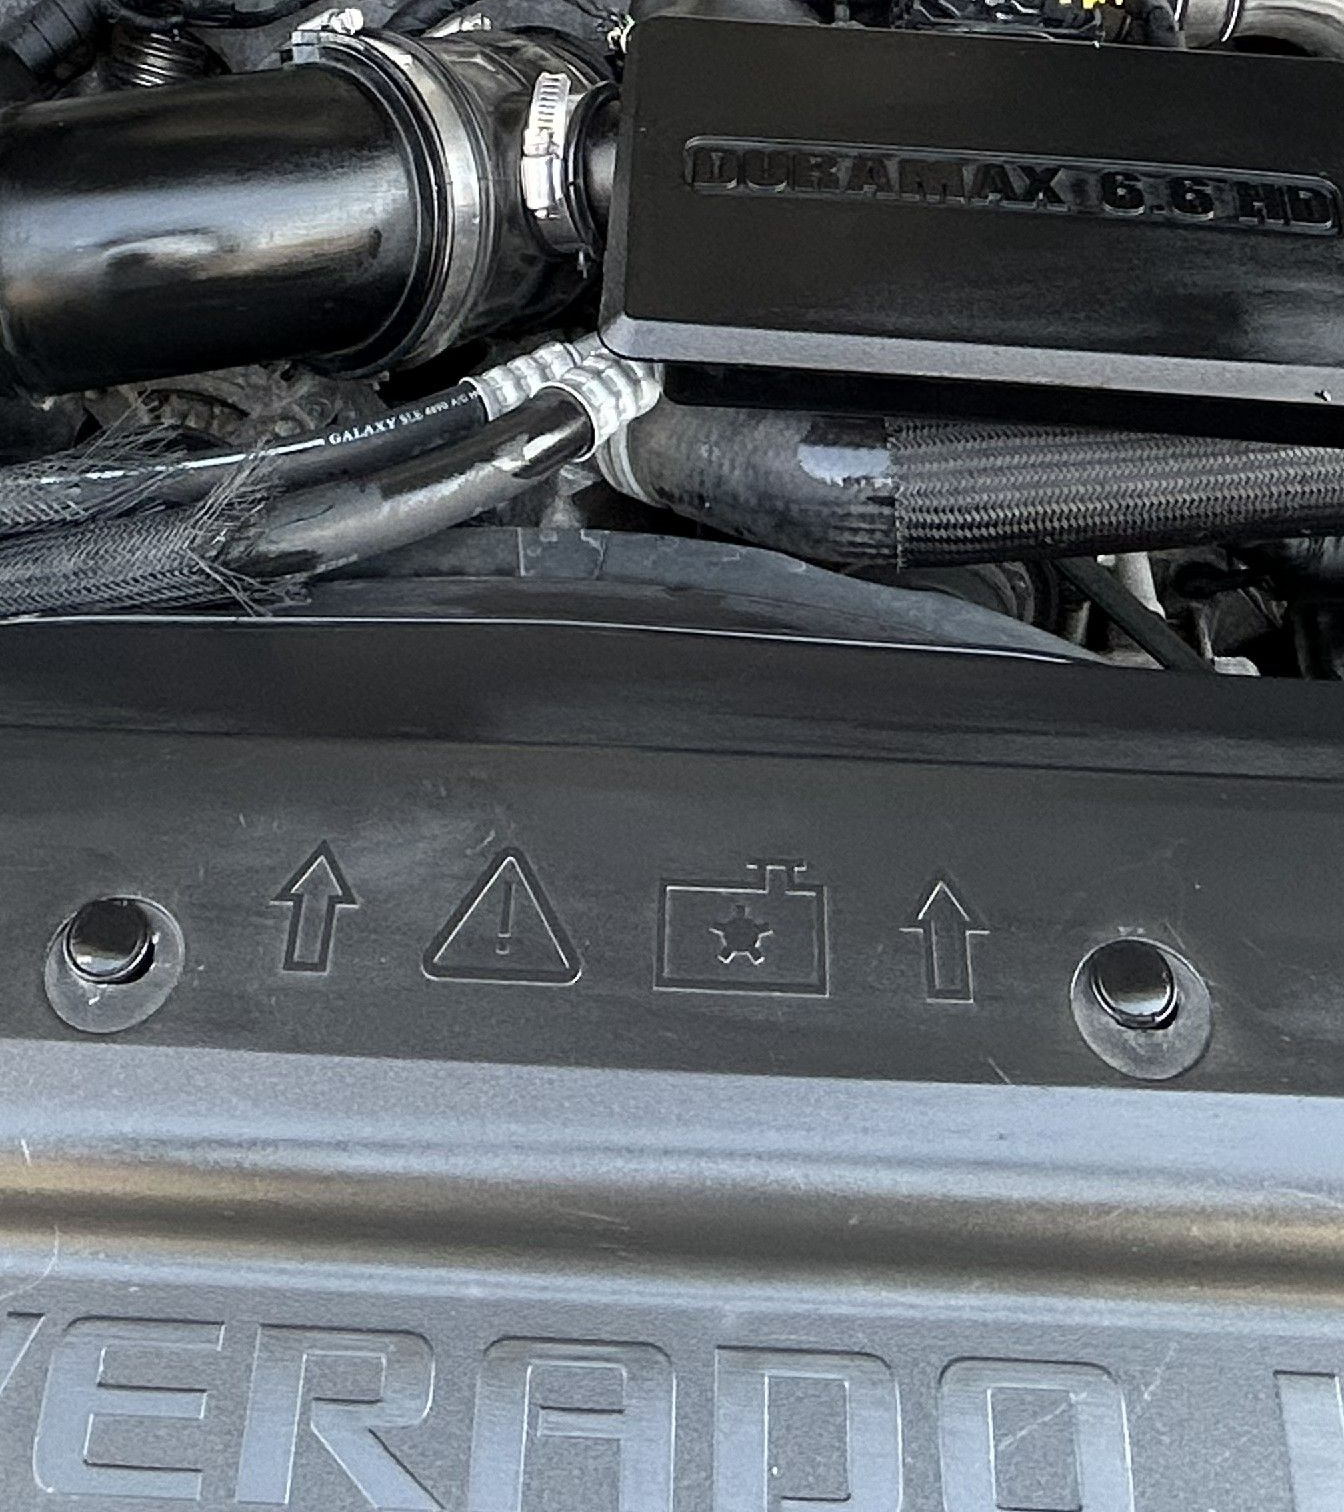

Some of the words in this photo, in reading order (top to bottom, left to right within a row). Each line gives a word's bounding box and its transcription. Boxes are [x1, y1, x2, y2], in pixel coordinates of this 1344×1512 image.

[692, 147, 1069, 212] DURAMAX
[1099, 170, 1215, 222] 6.6
[1235, 180, 1334, 230] HD
[328, 416, 396, 445] GALAXY
